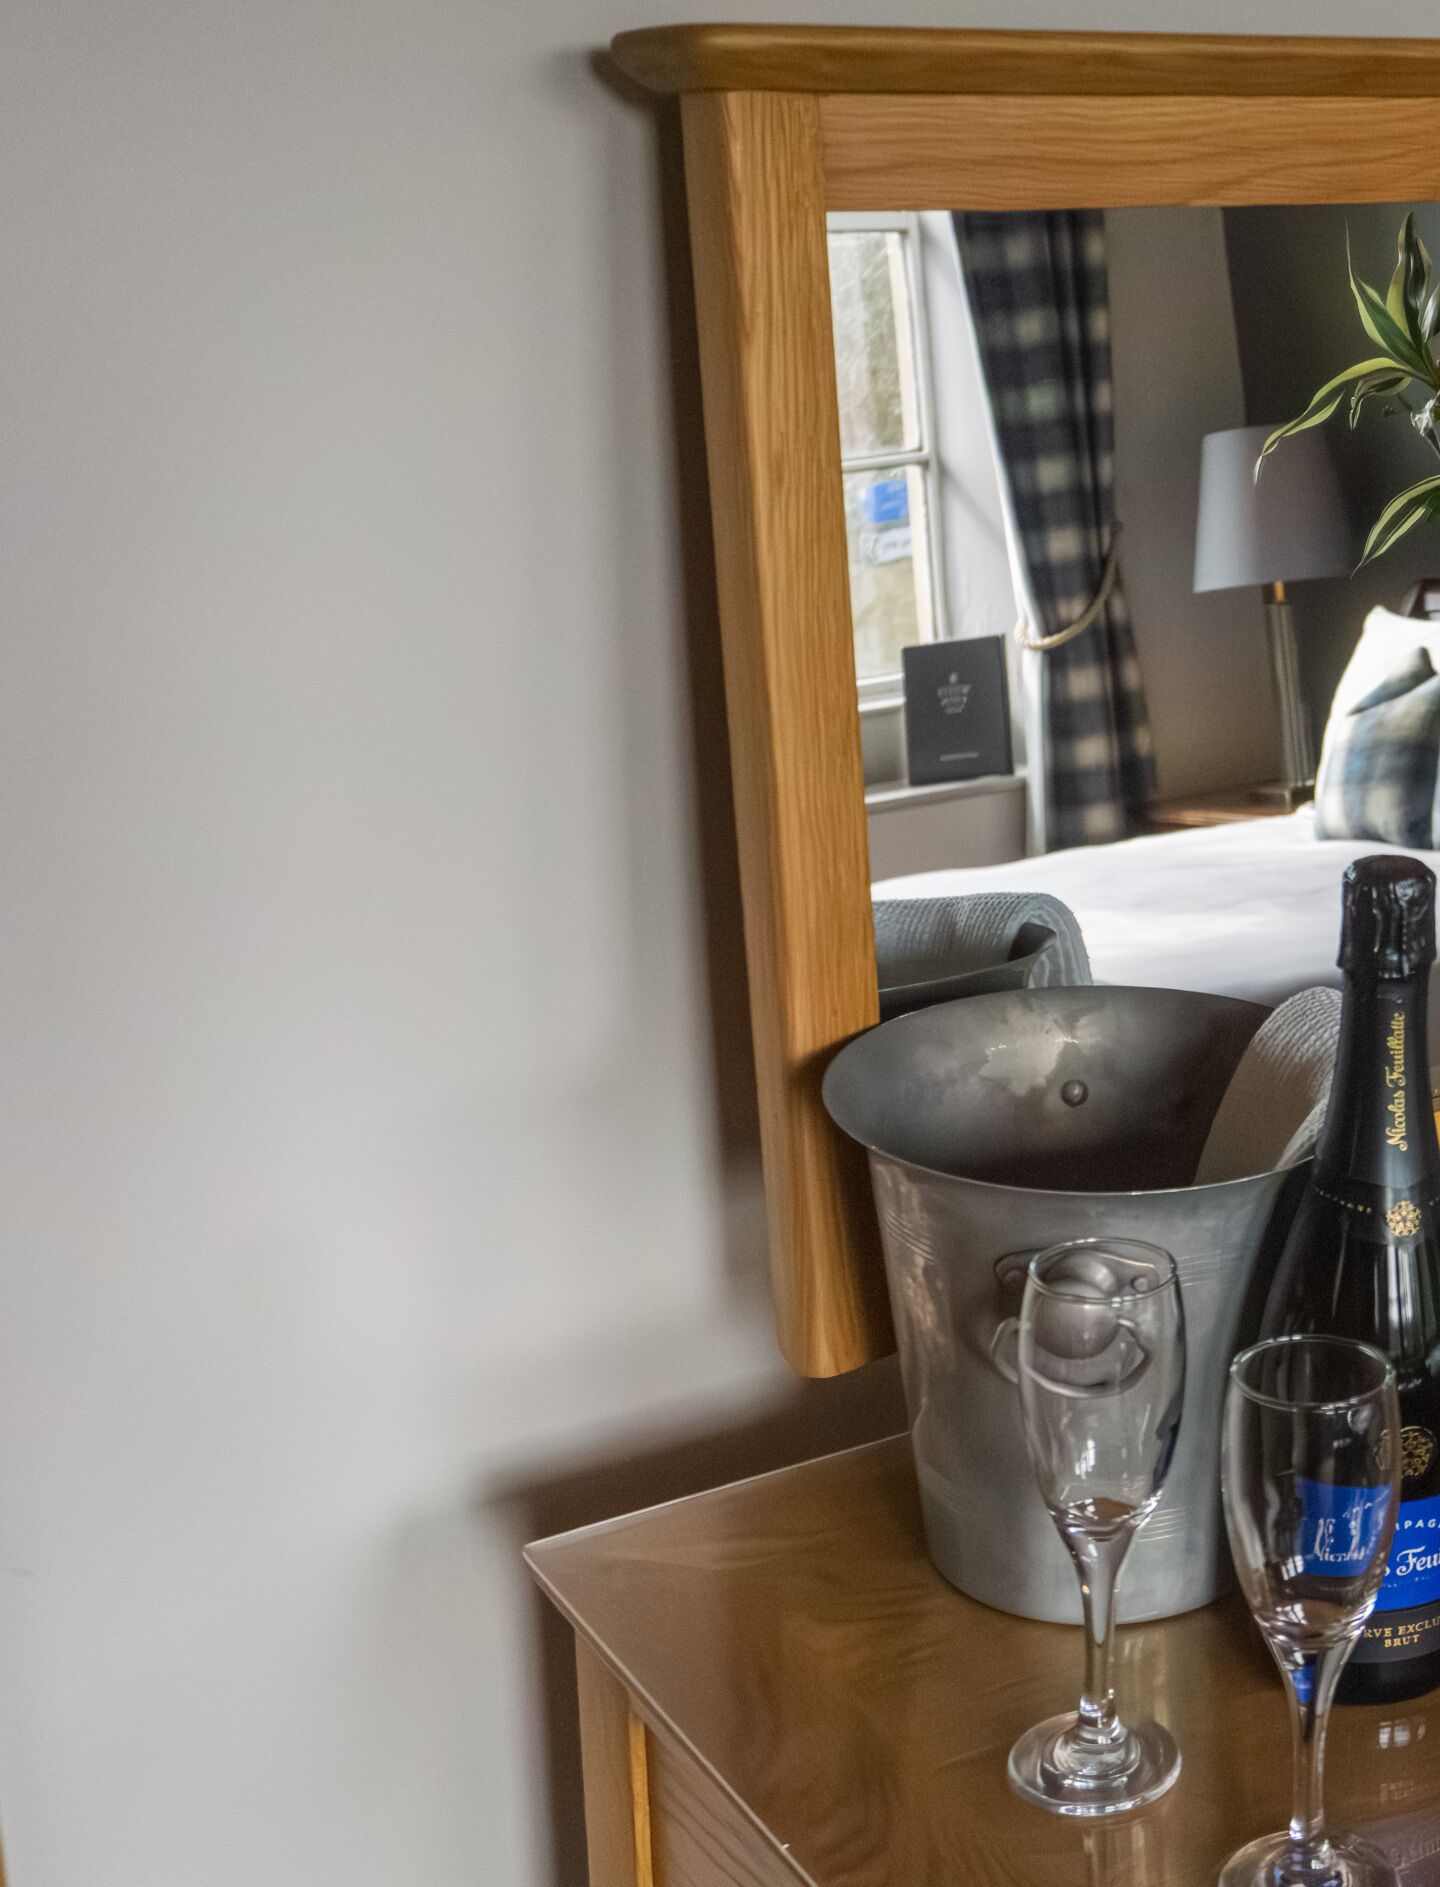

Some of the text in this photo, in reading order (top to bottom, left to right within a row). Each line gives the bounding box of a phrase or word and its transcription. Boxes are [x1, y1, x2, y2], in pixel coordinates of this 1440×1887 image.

[1385, 1011, 1408, 1152] Nicolas Feuillatte
[1384, 1634, 1420, 1648] BRUT
